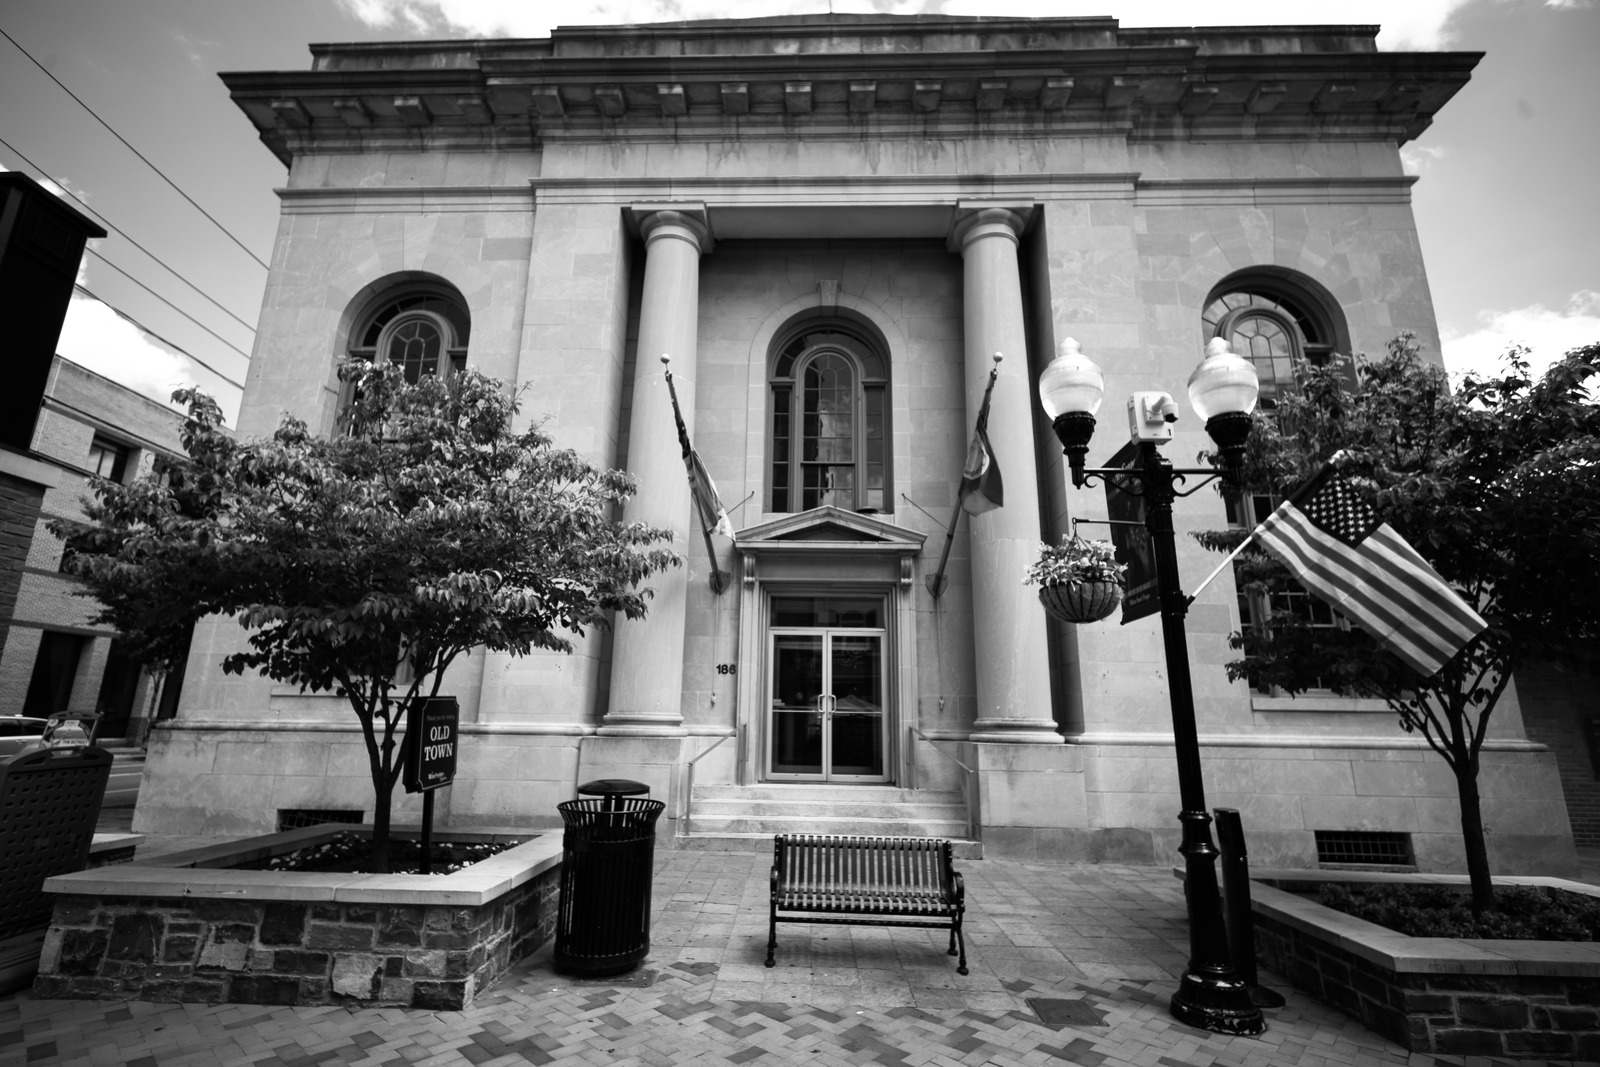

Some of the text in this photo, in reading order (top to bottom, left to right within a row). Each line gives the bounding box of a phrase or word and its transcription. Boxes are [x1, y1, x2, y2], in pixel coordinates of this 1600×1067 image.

[716, 663, 737, 675] 186
[430, 726, 450, 742] OLD
[424, 743, 453, 761] TOWN
